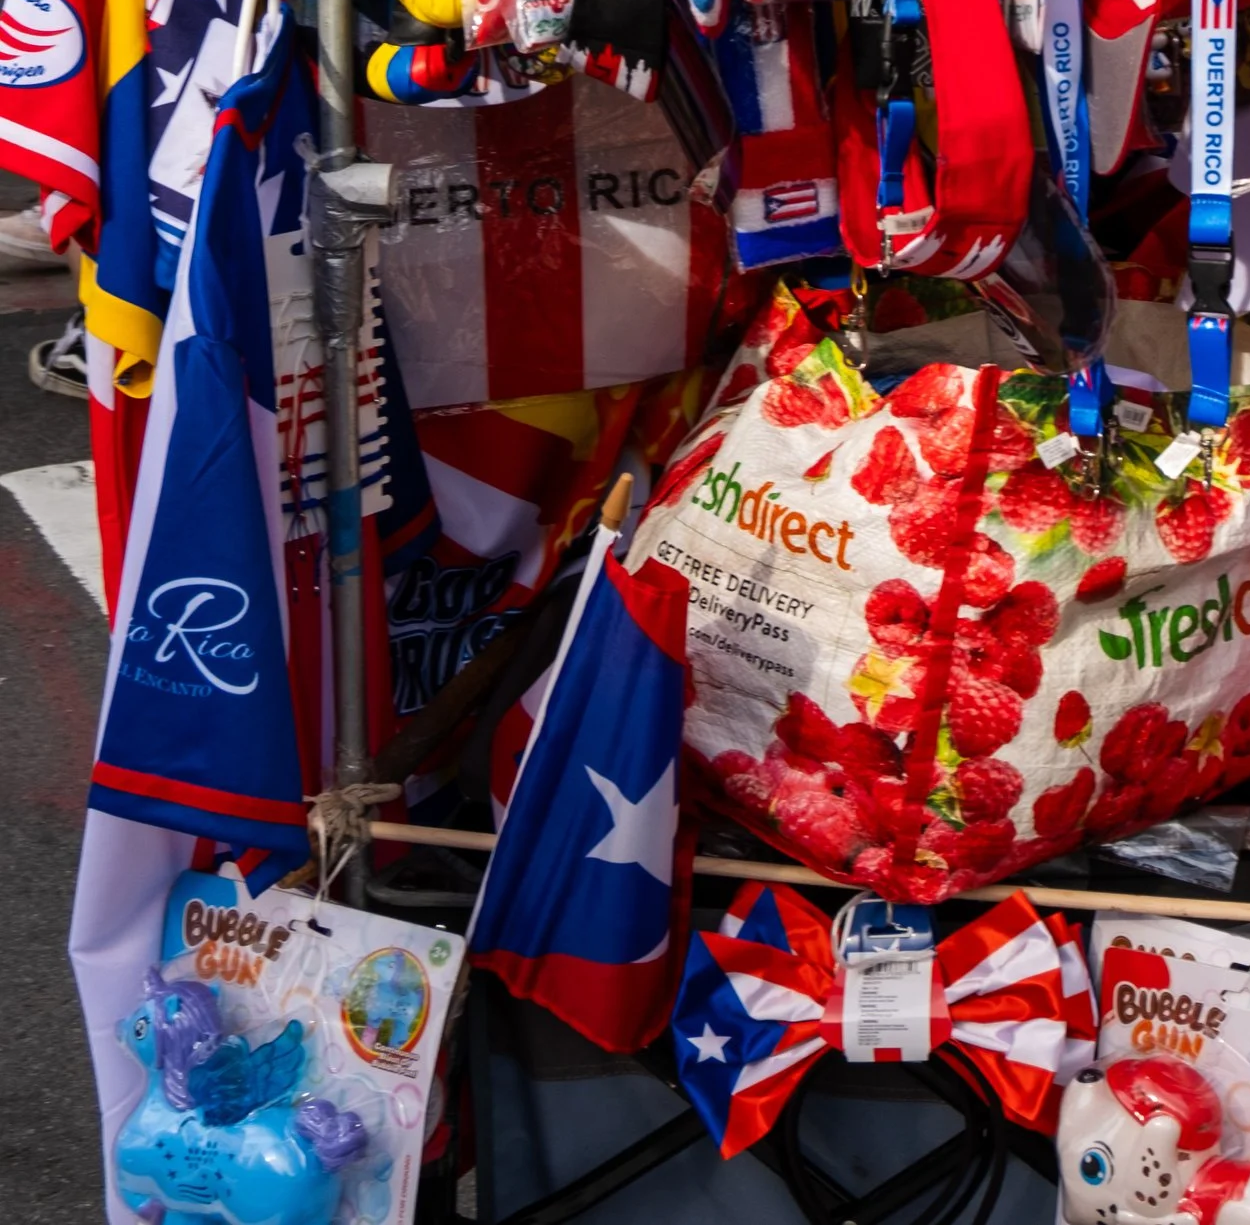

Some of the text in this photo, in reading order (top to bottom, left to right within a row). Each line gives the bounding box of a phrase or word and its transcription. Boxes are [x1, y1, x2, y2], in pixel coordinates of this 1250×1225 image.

[1053, 22, 1071, 73] RICO
[1204, 37, 1225, 186] PUERTO RICO
[396, 178, 565, 226] ERTO
[657, 540, 815, 619] GET FREE DELIVERY
[148, 577, 260, 695] Rico
[134, 667, 213, 698] ENCANTO
[183, 899, 290, 962] BUBBLE
[431, 945, 448, 959] 3+
[196, 941, 264, 988] GUN
[1116, 984, 1227, 1039] BUBBLE
[1131, 1019, 1204, 1059] GUN
